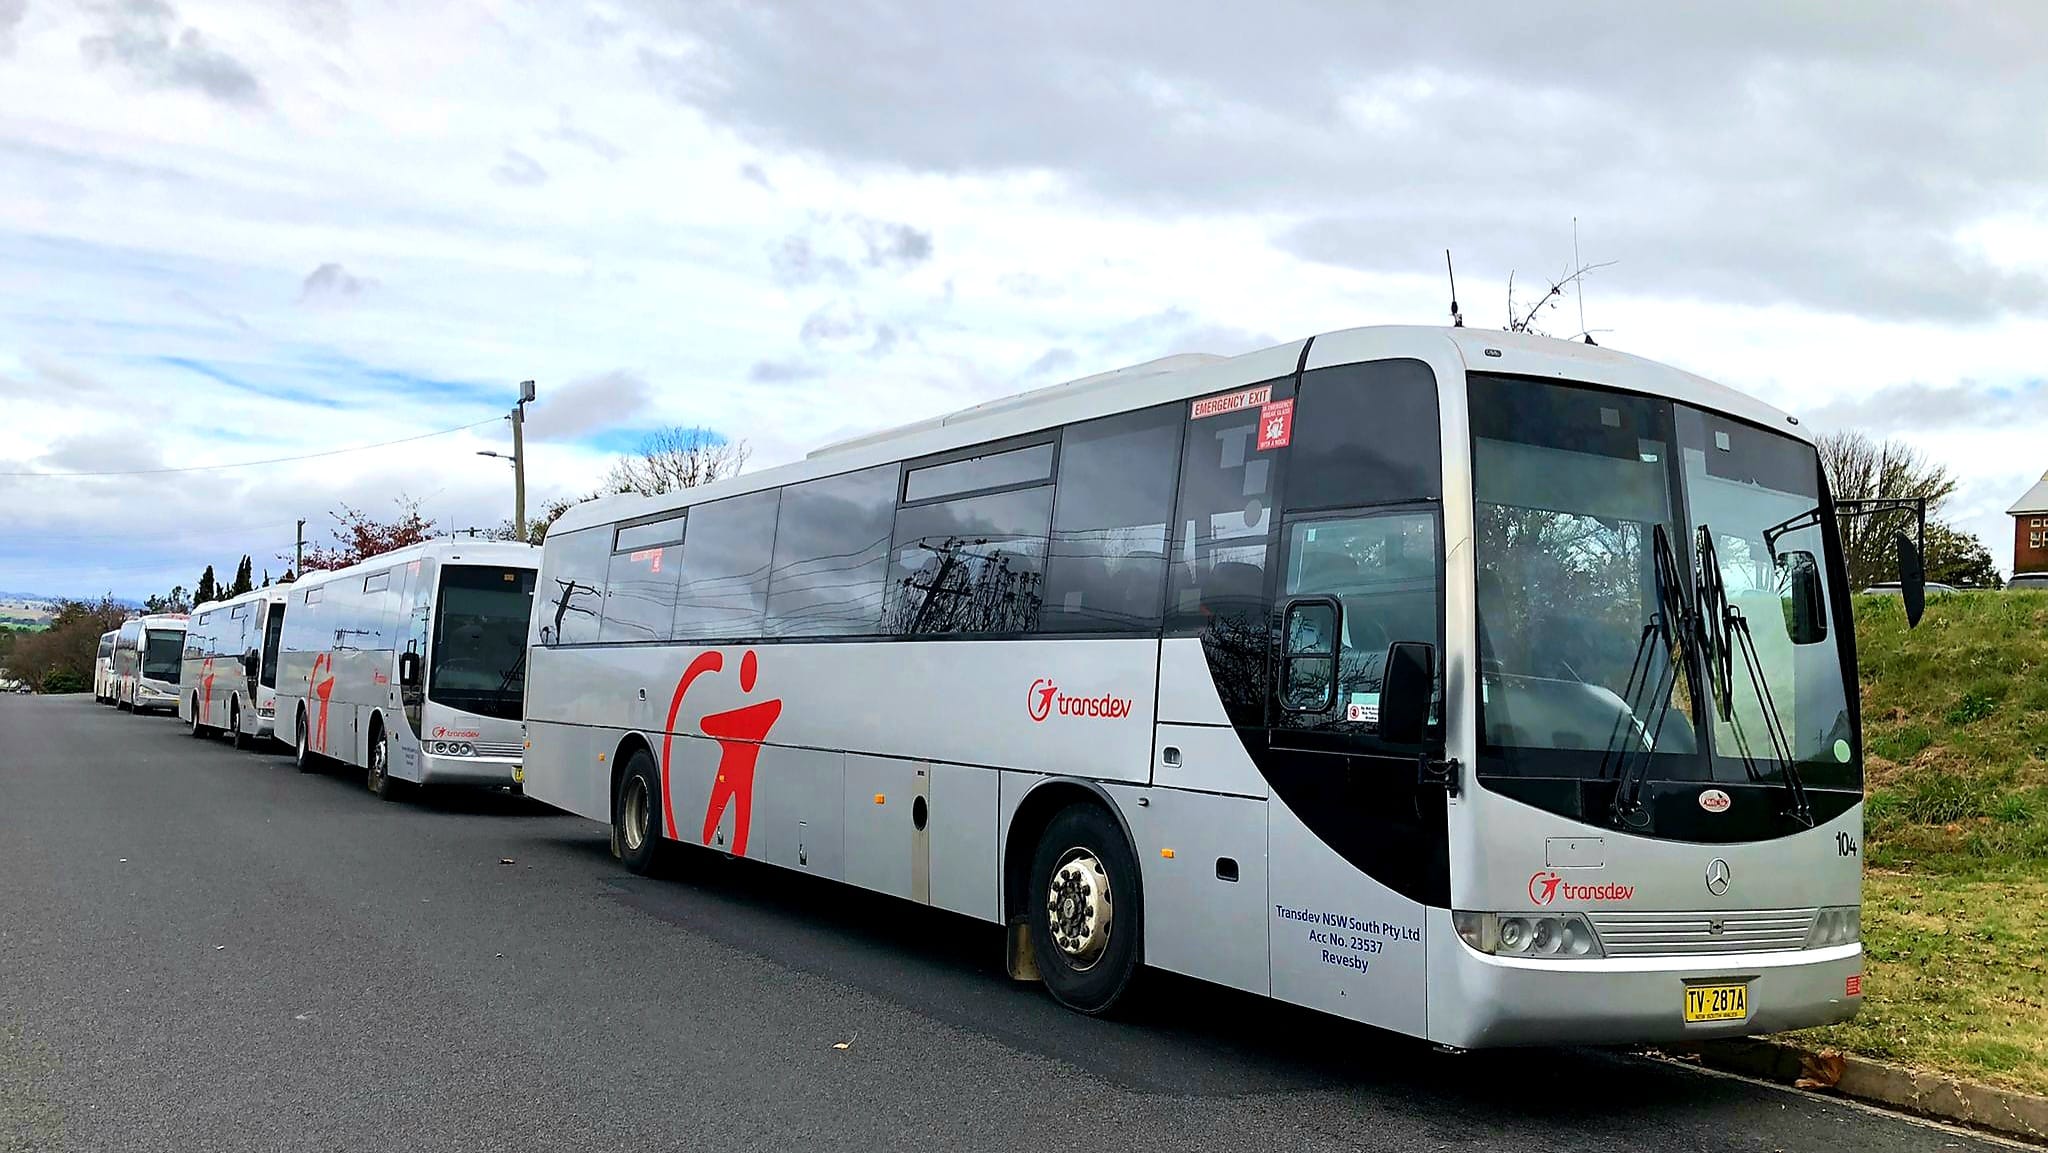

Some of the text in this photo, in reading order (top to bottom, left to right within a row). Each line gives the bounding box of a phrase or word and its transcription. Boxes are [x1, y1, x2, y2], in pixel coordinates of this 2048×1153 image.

[1195, 389, 1268, 415] EMERGENCY EXIT
[1057, 693, 1132, 718] transdev
[1835, 831, 1857, 857] 104
[1562, 882, 1634, 900] transdev
[1276, 905, 1420, 941] Transdev NSW South Pty Ltd
[1309, 929, 1383, 953] Acc No. 23537
[1322, 950, 1369, 973] Revesby
